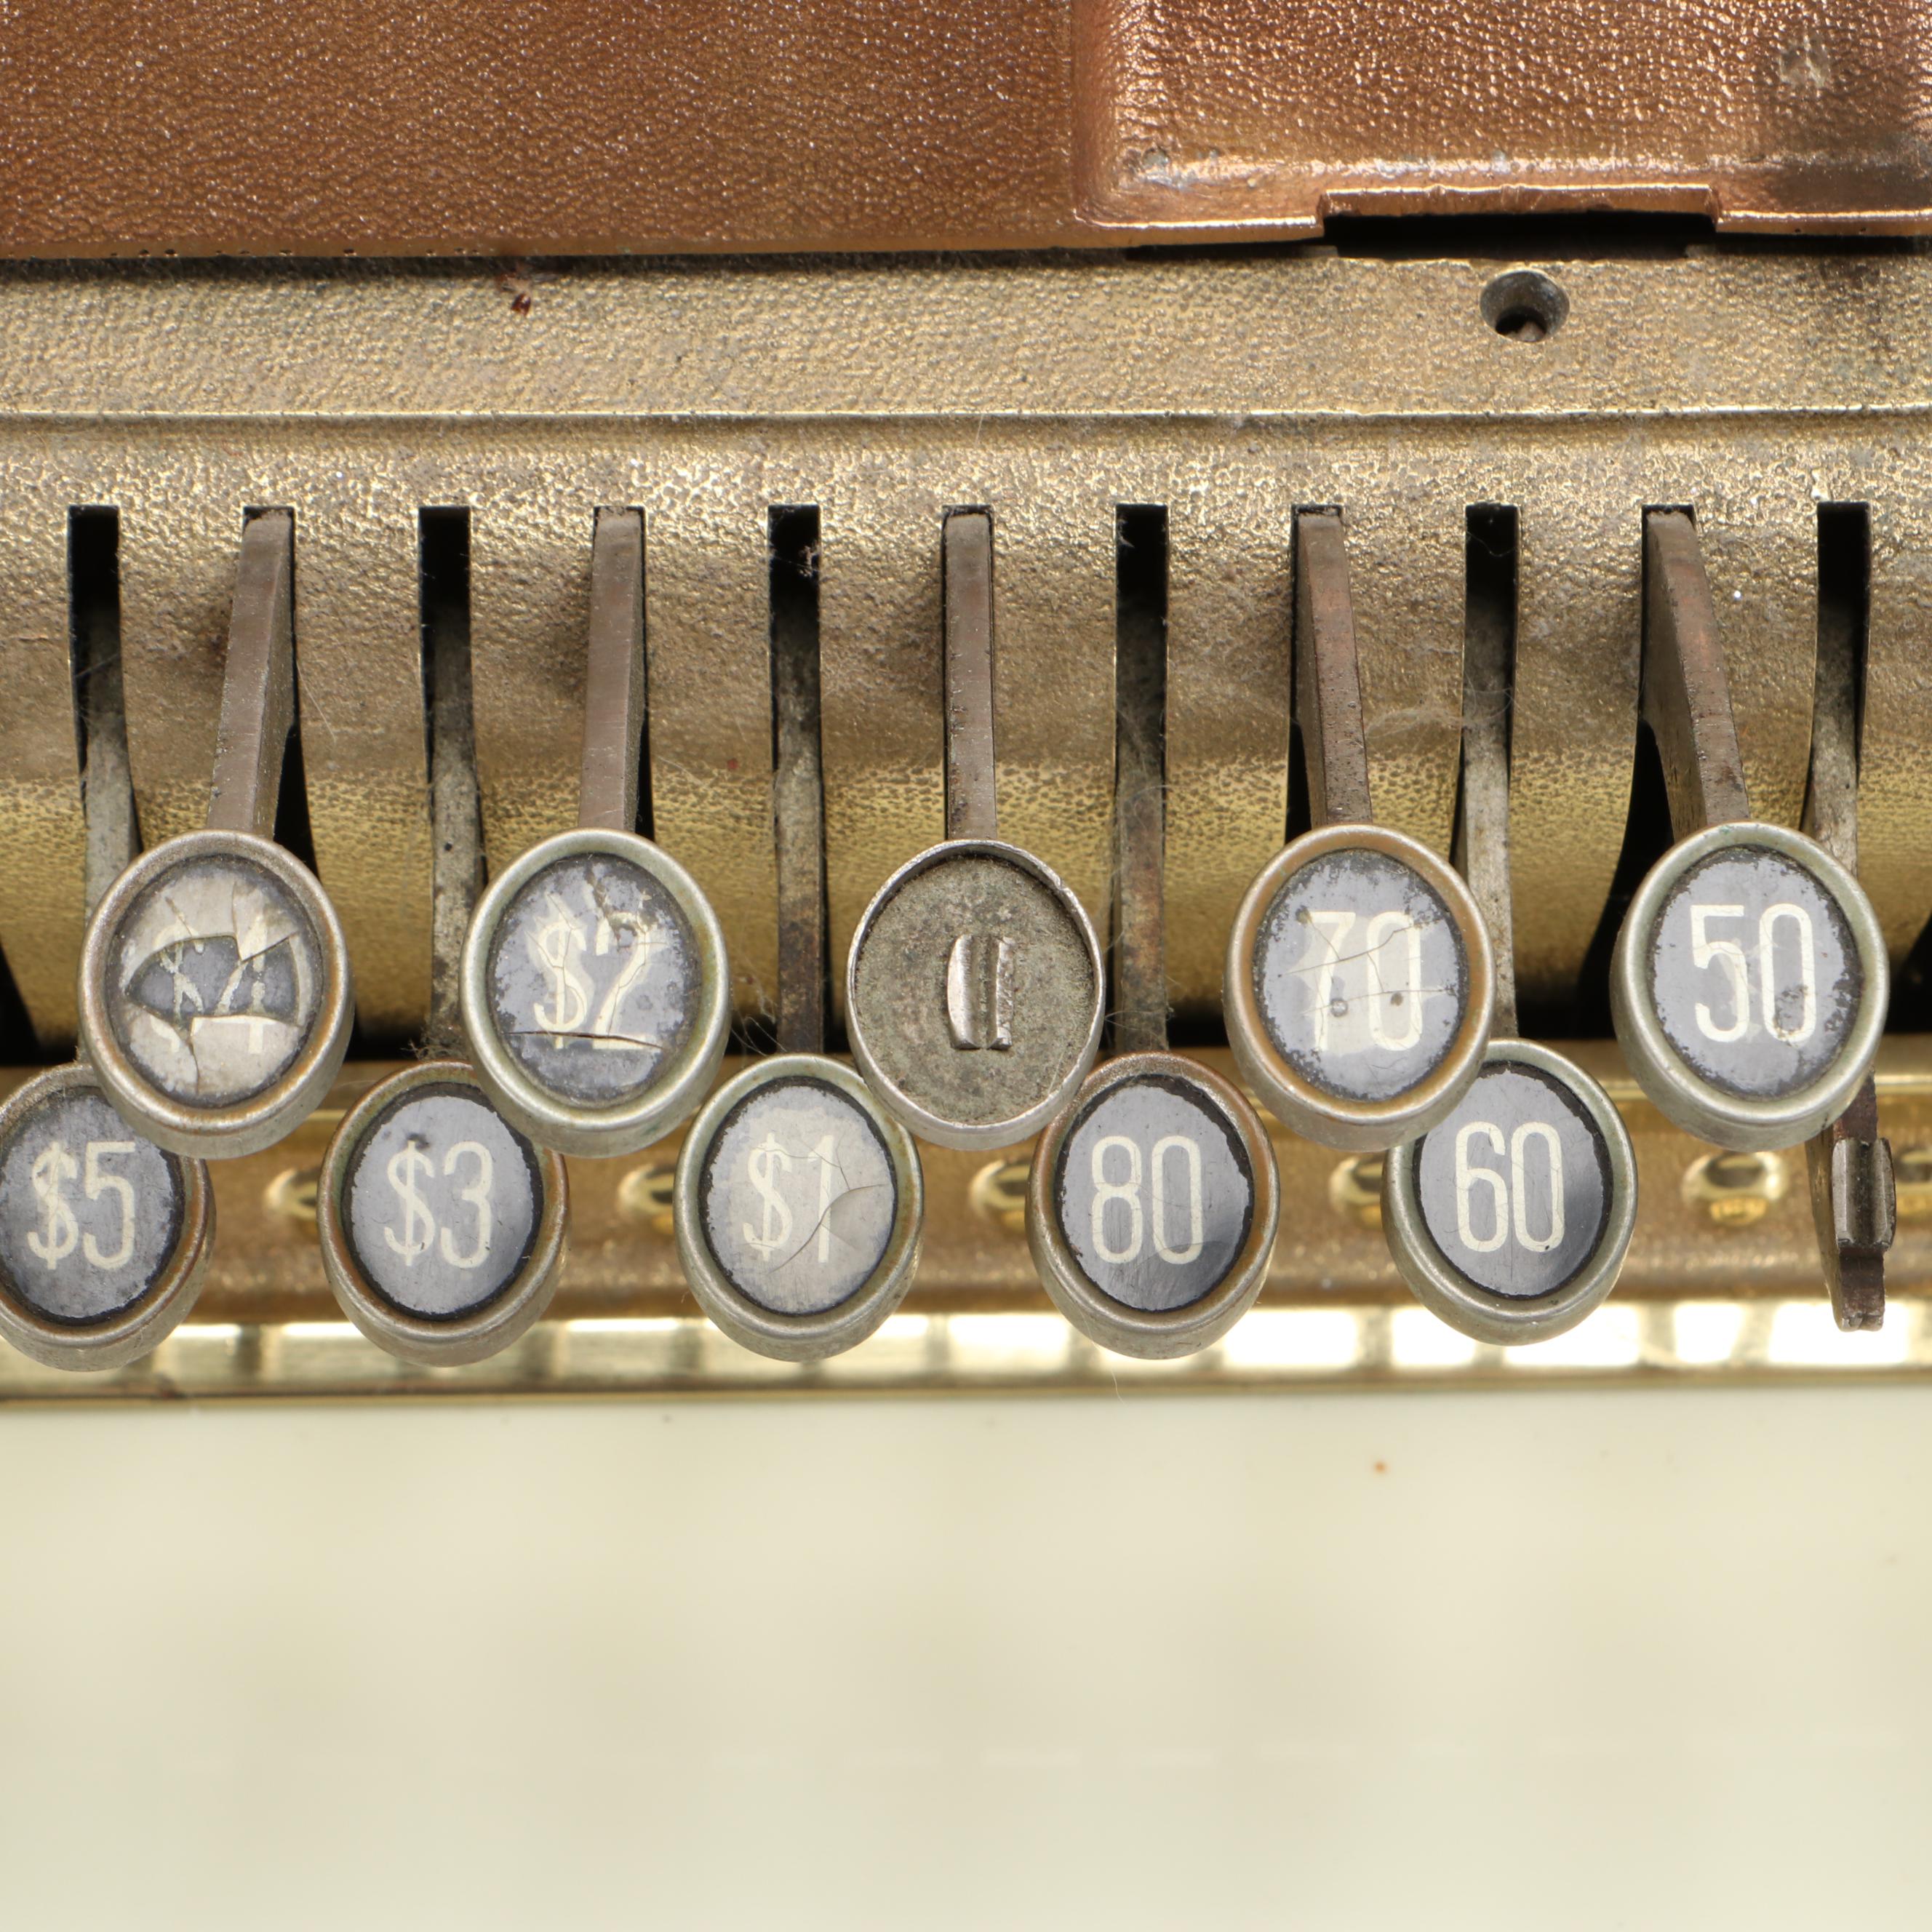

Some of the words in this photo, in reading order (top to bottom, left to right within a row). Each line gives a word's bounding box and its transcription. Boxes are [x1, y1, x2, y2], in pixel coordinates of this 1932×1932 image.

[533, 910, 650, 1050] $2
[1309, 911, 1423, 1052] 70
[1690, 903, 1818, 1047] 50
[27, 1141, 137, 1270] $5
[383, 1140, 493, 1269] $3
[743, 1132, 837, 1264] $1
[1091, 1135, 1204, 1266] 80
[1455, 1121, 1565, 1253] 60
